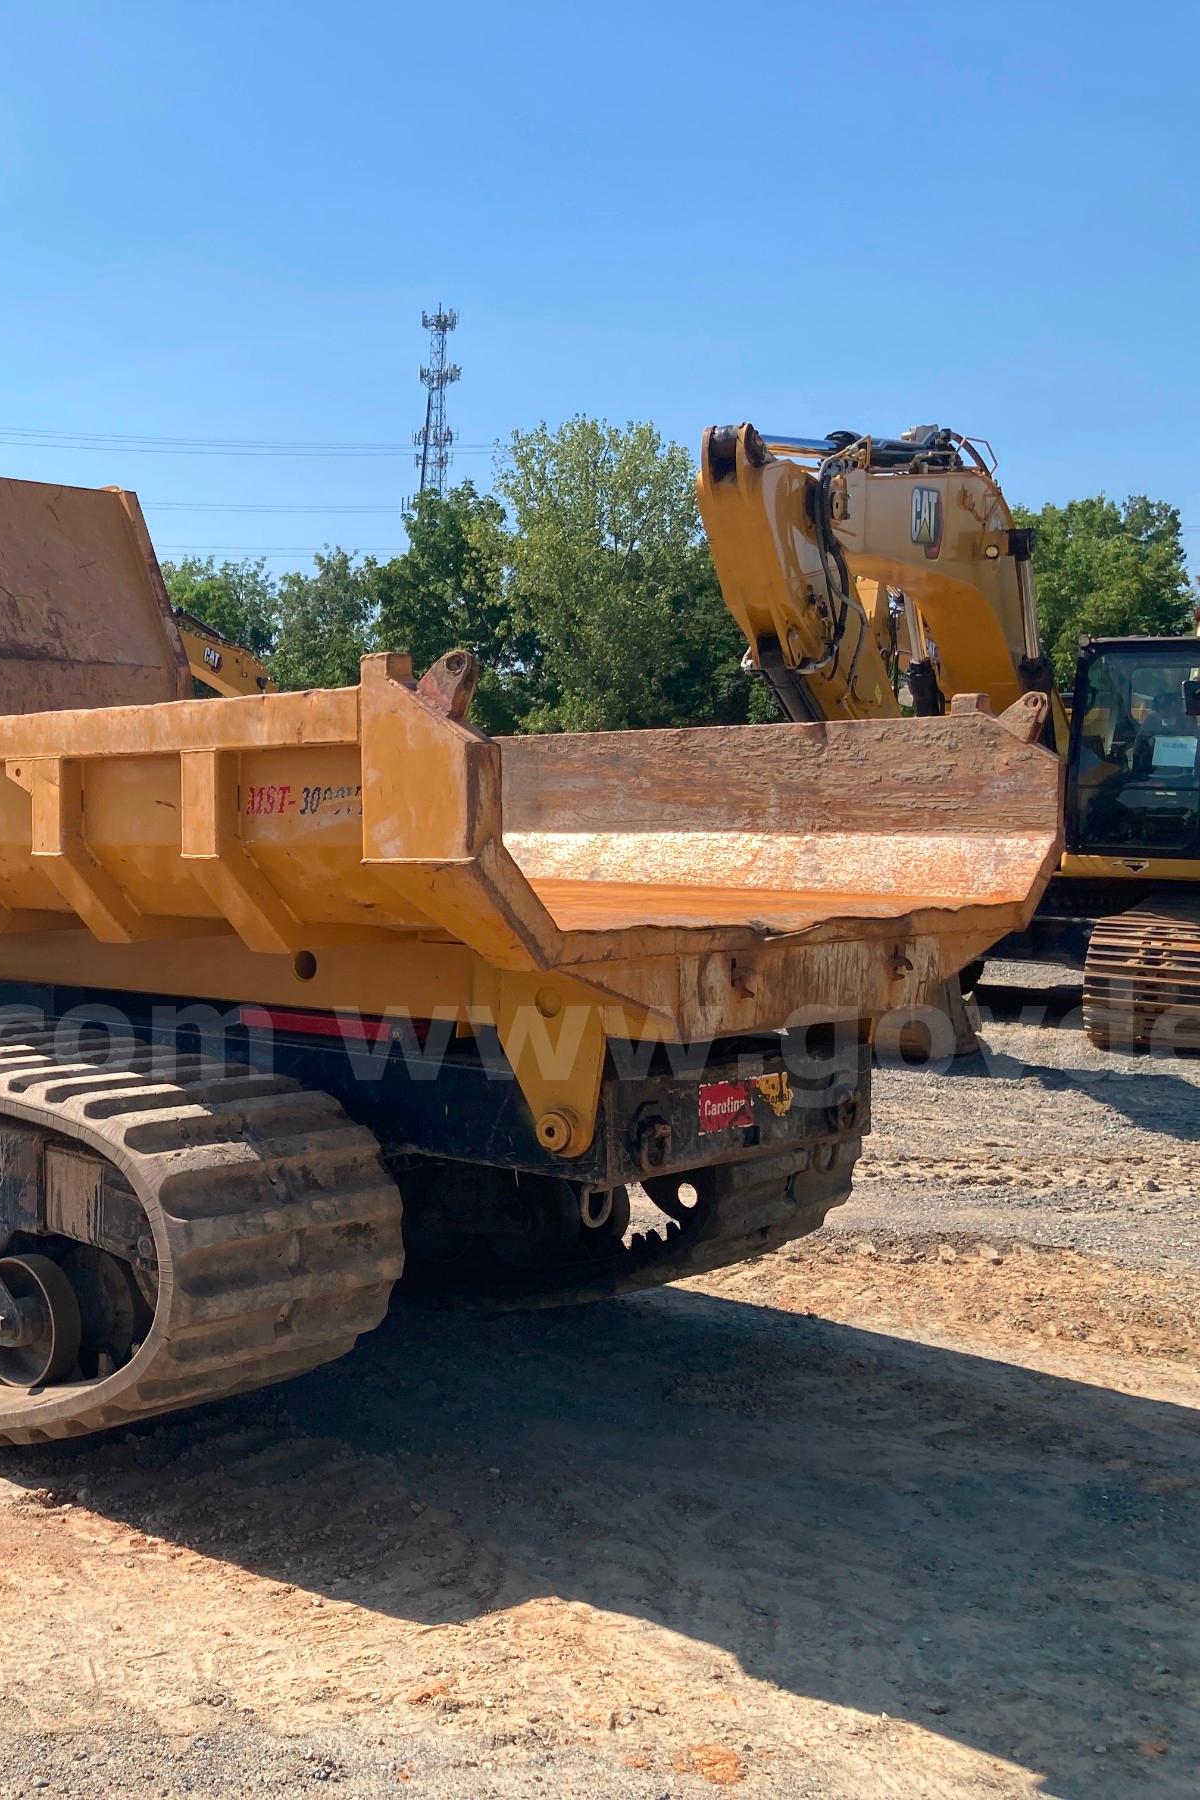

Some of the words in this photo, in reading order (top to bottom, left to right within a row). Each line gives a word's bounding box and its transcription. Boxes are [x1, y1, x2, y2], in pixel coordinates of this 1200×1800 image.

[911, 488, 938, 543] CAT
[204, 646, 220, 668] CAT
[704, 1096, 746, 1117] Carolina
